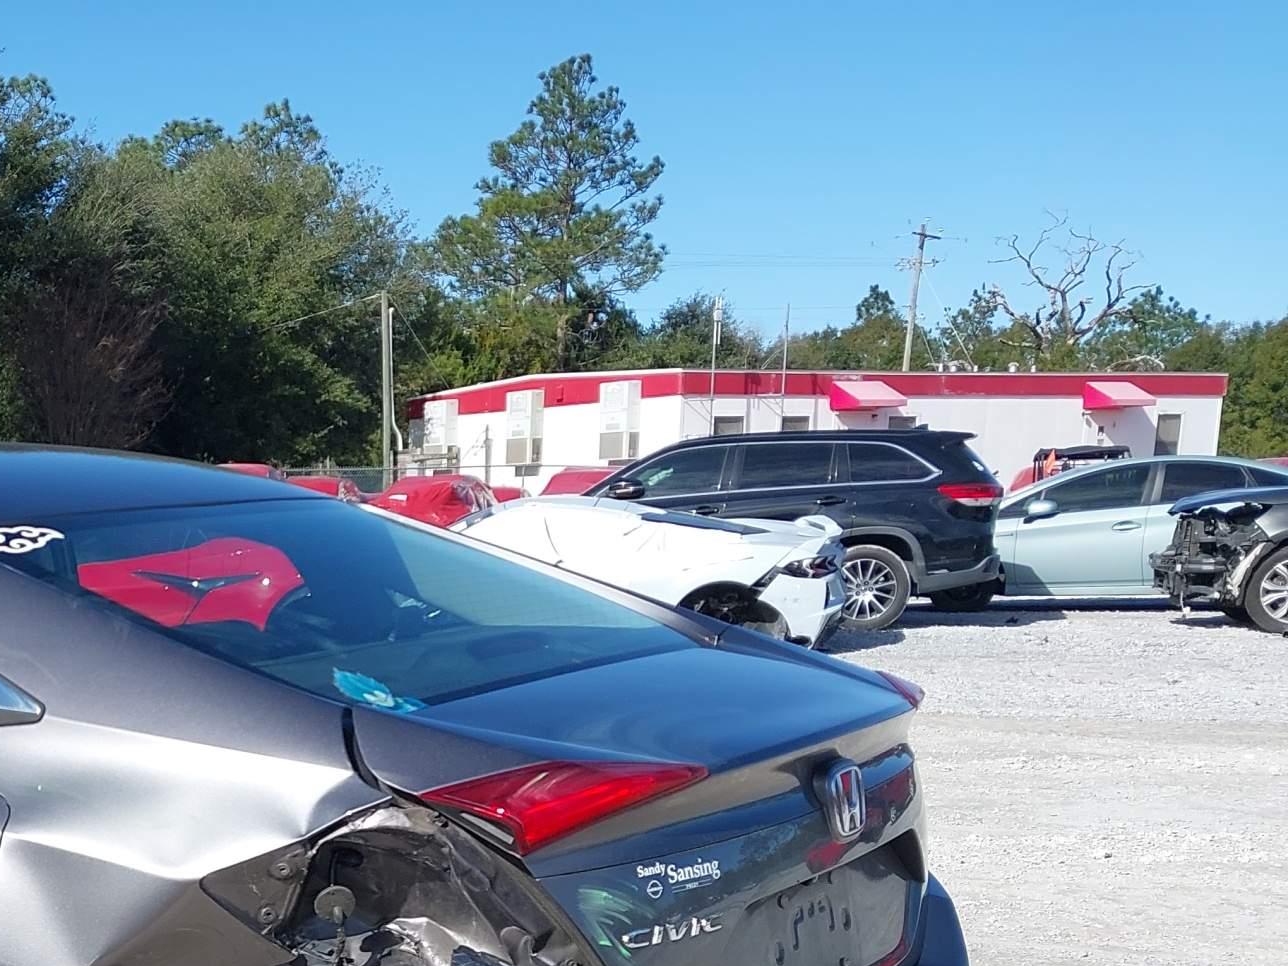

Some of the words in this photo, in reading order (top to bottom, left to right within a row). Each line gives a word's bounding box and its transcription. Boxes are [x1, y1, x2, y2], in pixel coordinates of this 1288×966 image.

[636, 862, 666, 878] Sandy
[667, 857, 721, 884] Sansing
[621, 912, 723, 949] CIVIC
